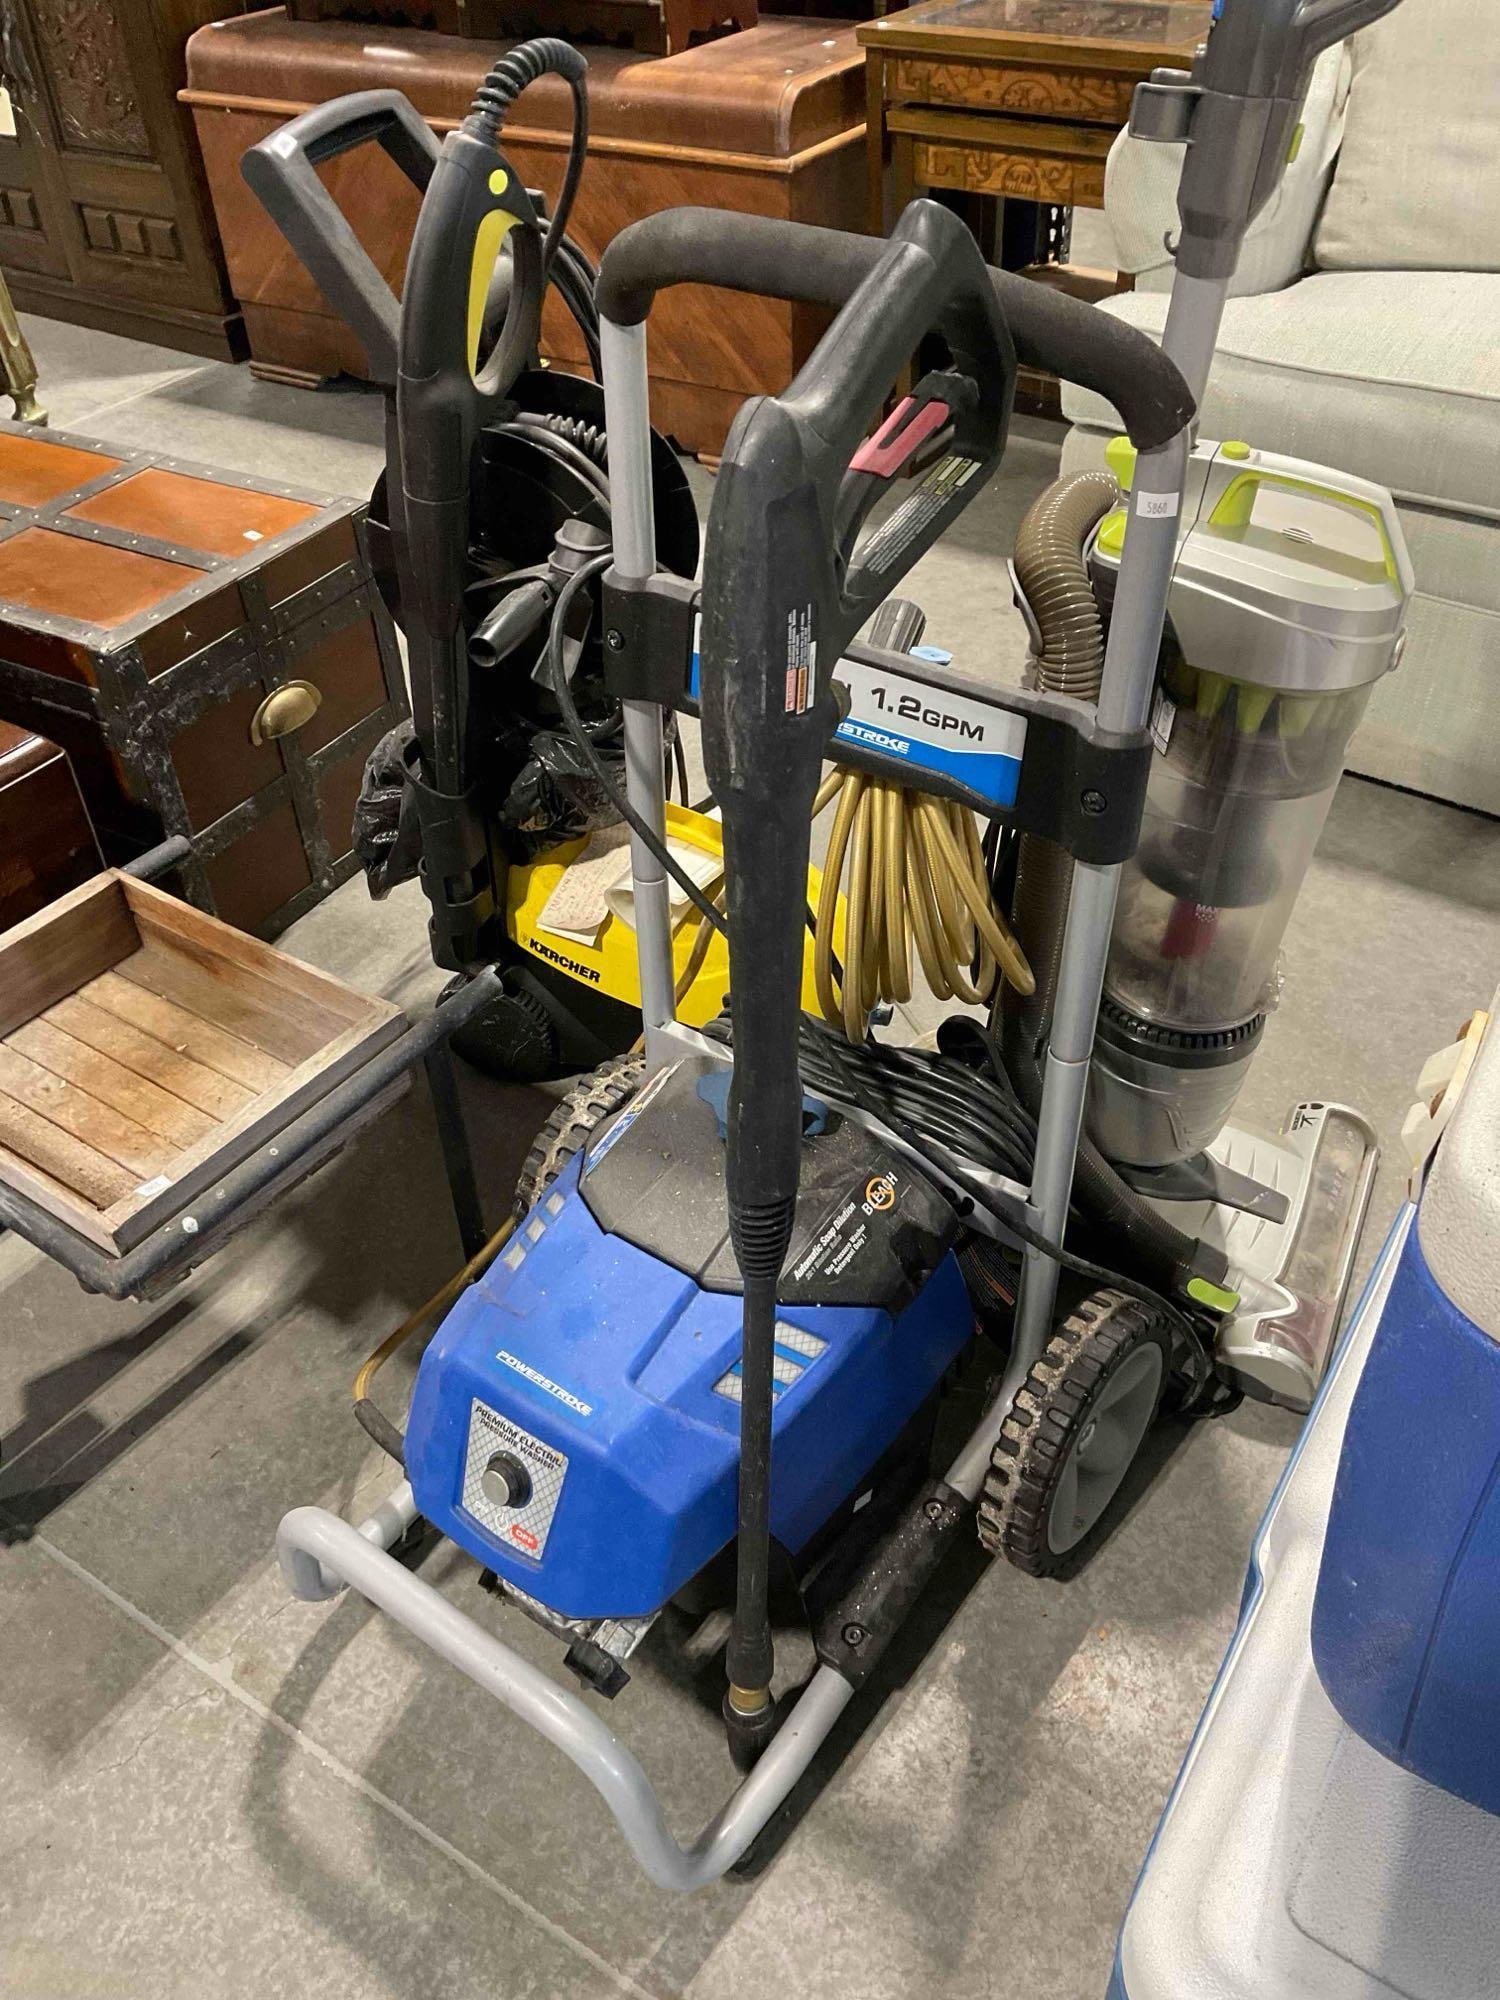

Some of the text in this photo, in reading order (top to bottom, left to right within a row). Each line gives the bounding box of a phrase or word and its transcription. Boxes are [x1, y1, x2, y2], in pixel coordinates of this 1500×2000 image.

[871, 687, 985, 742] 1.2GPM
[861, 1171, 898, 1216] BLEACH
[794, 1201, 856, 1281] Automatic Soap Dilution
[824, 1263, 835, 1276] Use
[832, 1241, 852, 1265] Pressure
[833, 1247, 856, 1275] Detergent
[496, 1350, 593, 1416] POWERSTROKE
[475, 1406, 518, 1438] PREMIUM
[480, 1419, 554, 1470] PRESSURE WASHER
